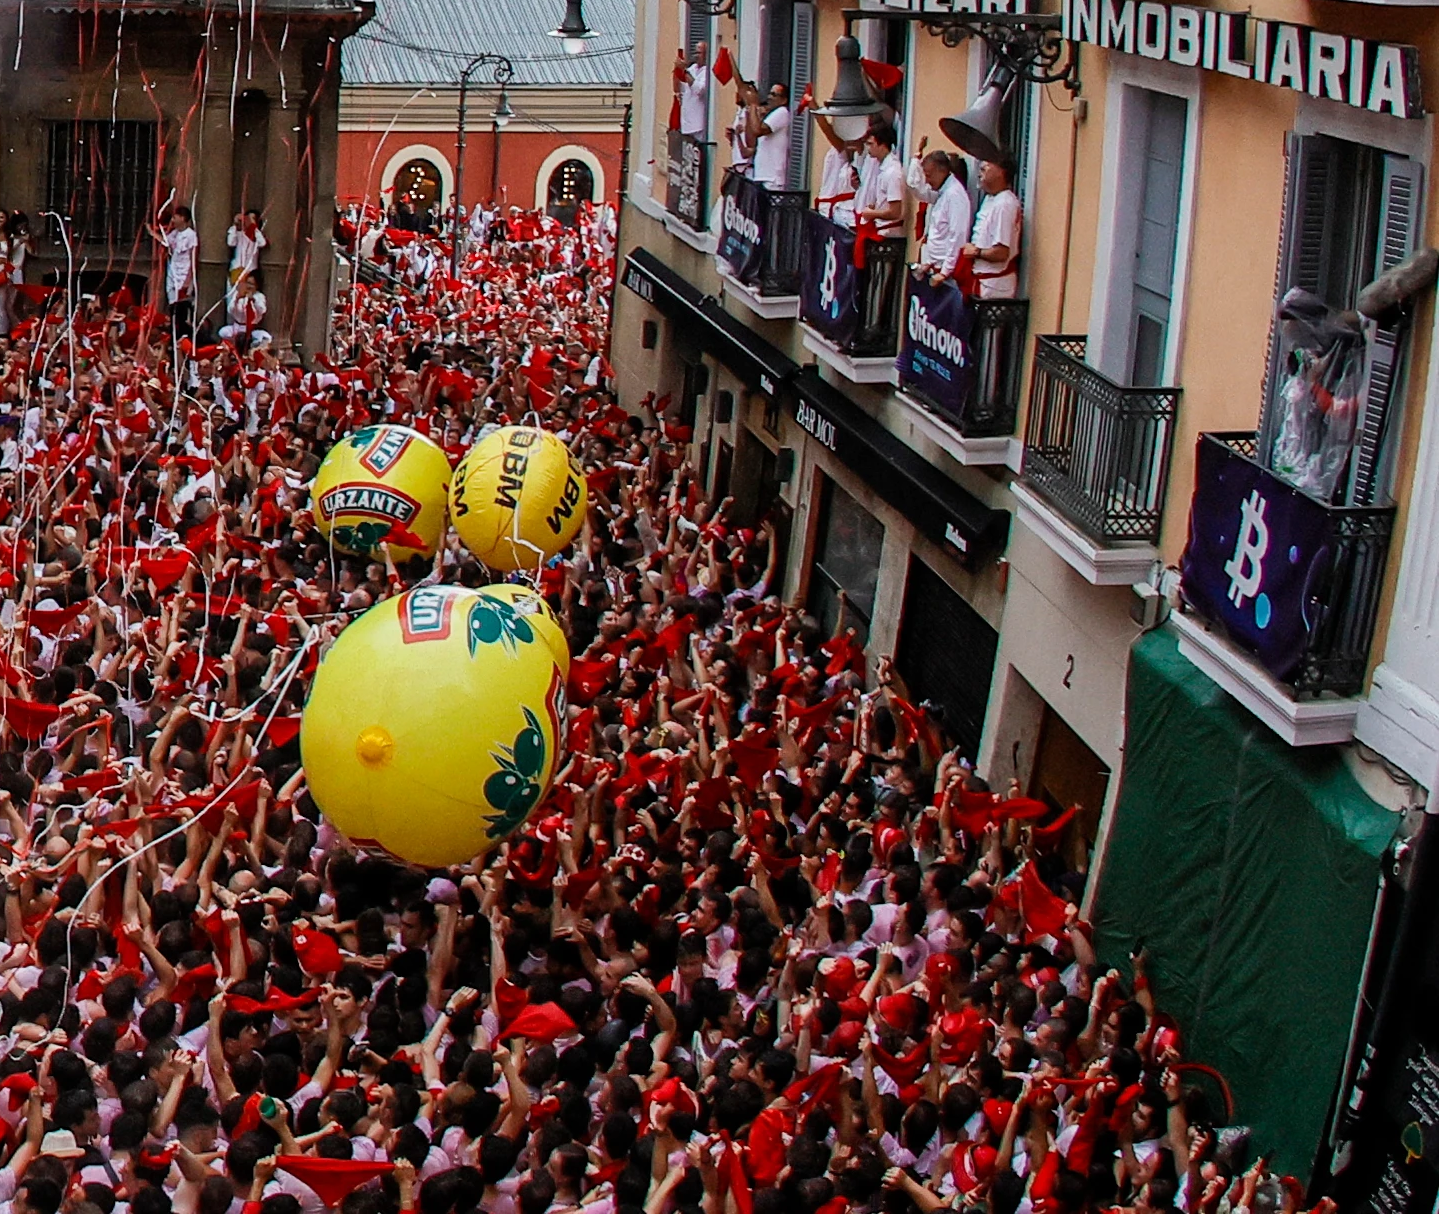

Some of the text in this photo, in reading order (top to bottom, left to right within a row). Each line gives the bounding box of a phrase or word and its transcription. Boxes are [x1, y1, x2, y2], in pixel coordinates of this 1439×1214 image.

[795, 398, 838, 452] BAR MOL
[493, 450, 529, 510] BM
[323, 485, 410, 522] URZANTE
[1061, 653, 1075, 689] 2
